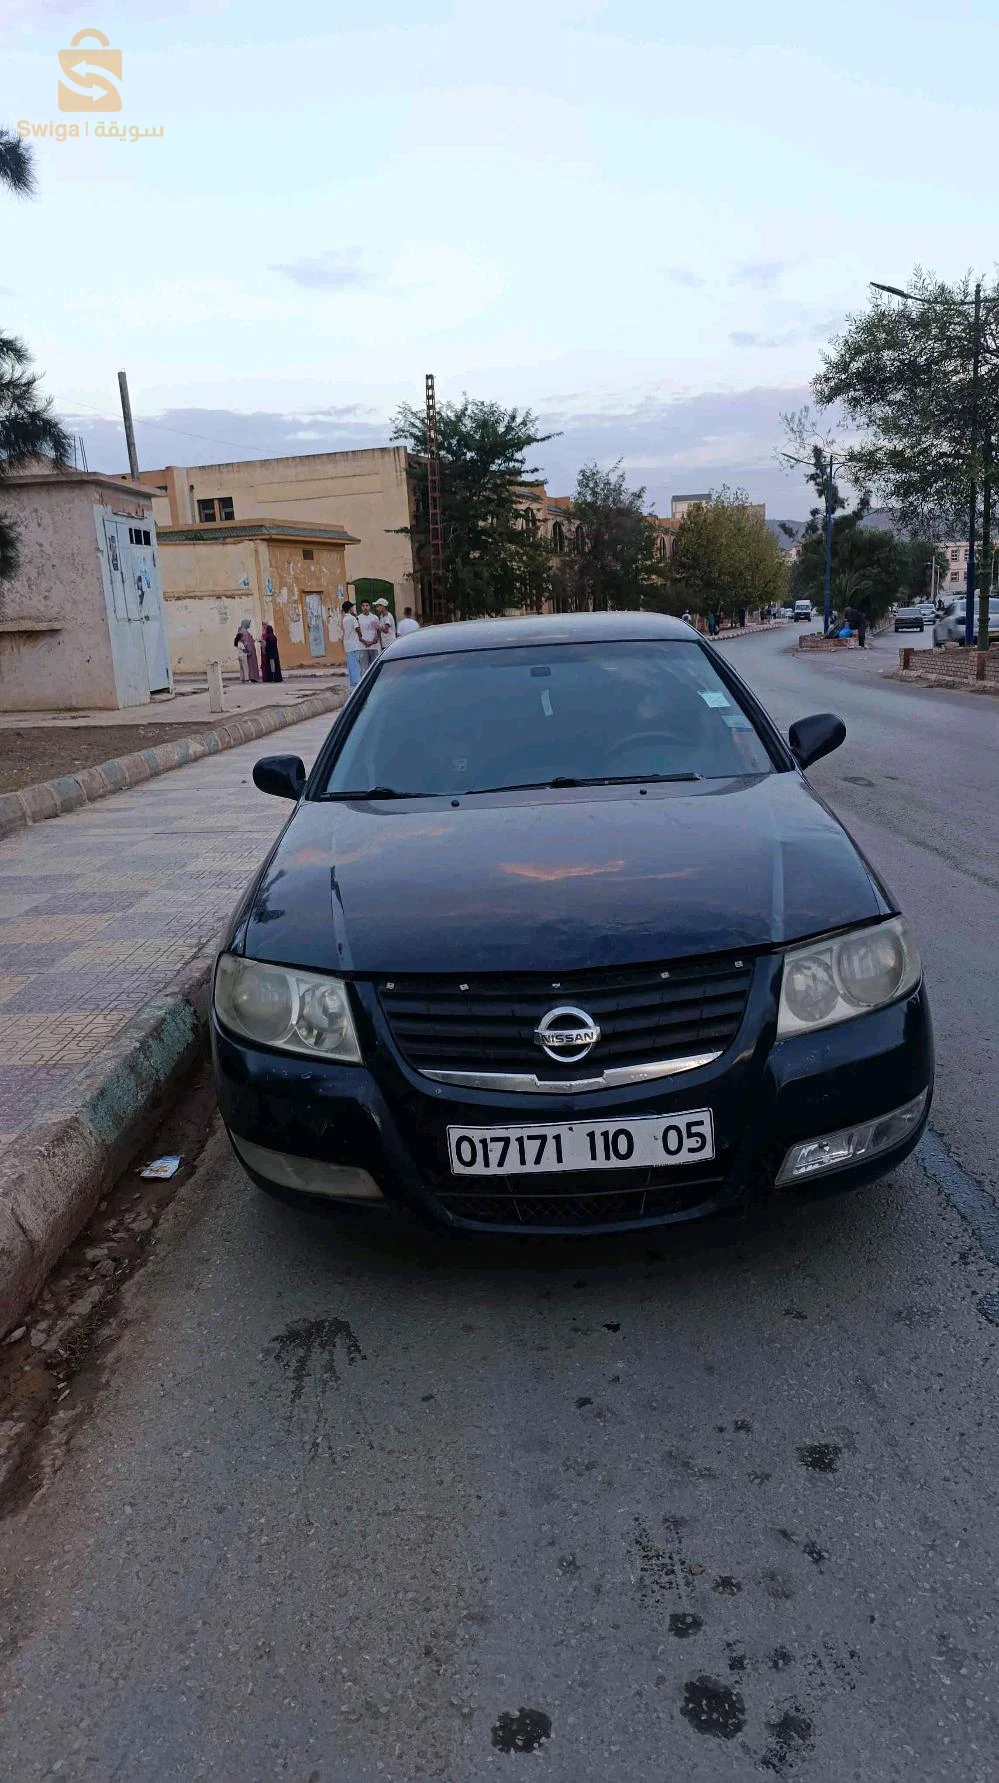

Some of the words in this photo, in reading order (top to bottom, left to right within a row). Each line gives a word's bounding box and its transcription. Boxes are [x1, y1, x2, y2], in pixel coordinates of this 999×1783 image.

[541, 1031, 594, 1044] NISSAN
[455, 1134, 564, 1168] 017171
[586, 1128, 634, 1161] 110
[662, 1120, 707, 1156] 05
